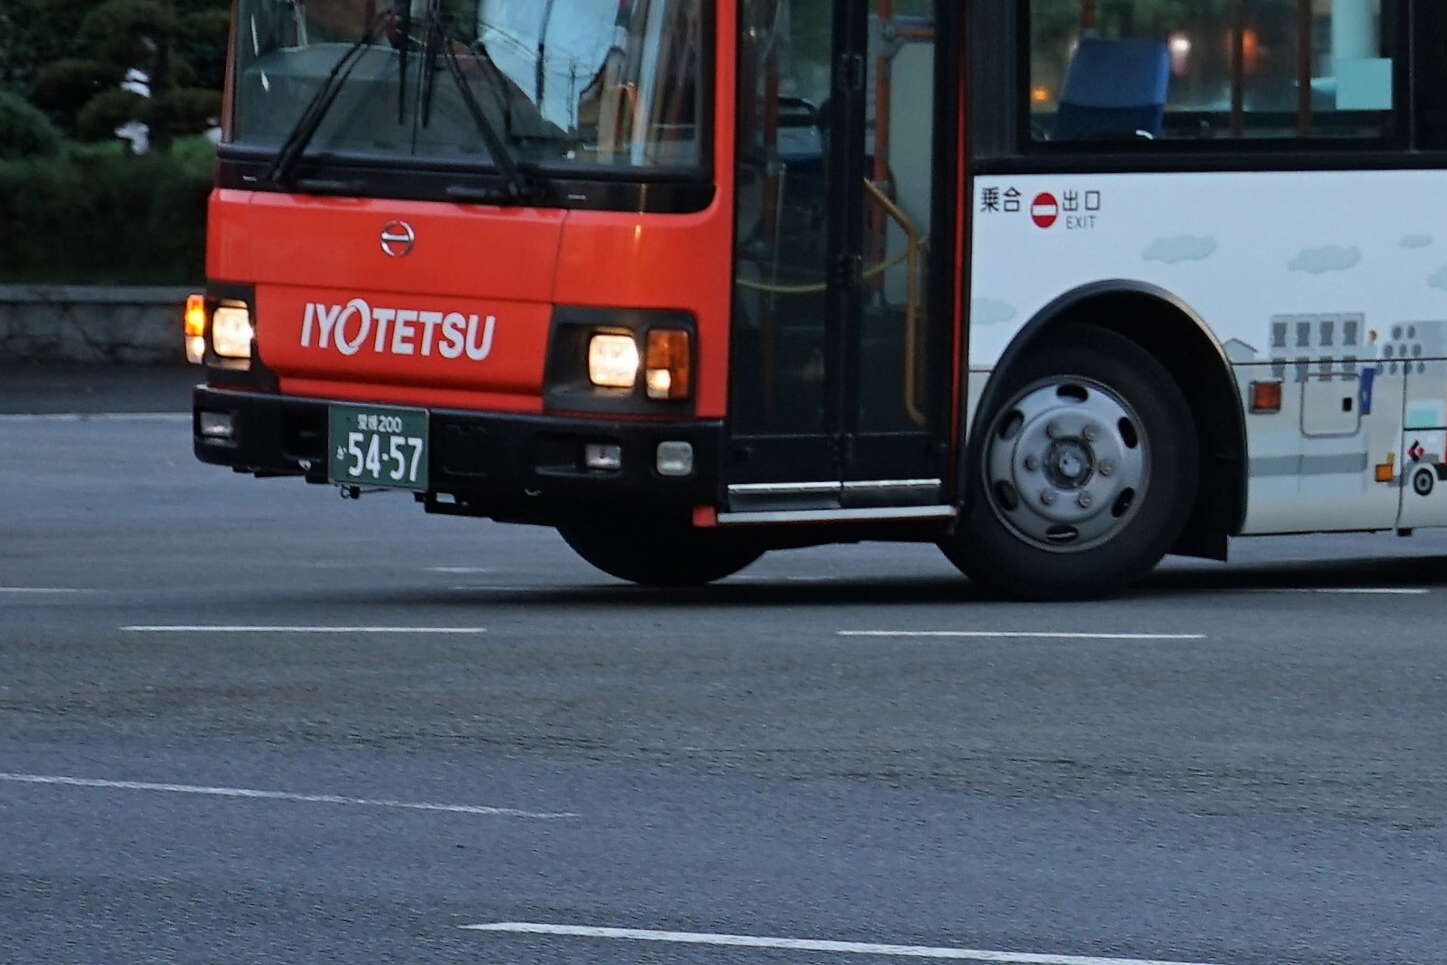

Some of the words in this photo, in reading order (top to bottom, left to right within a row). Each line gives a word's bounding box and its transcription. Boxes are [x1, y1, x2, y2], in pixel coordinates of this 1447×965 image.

[980, 186, 1022, 213] 乗合
[1062, 189, 1101, 212] 出口
[1066, 215, 1097, 230] EXIT
[300, 297, 496, 361] IYOTETSU
